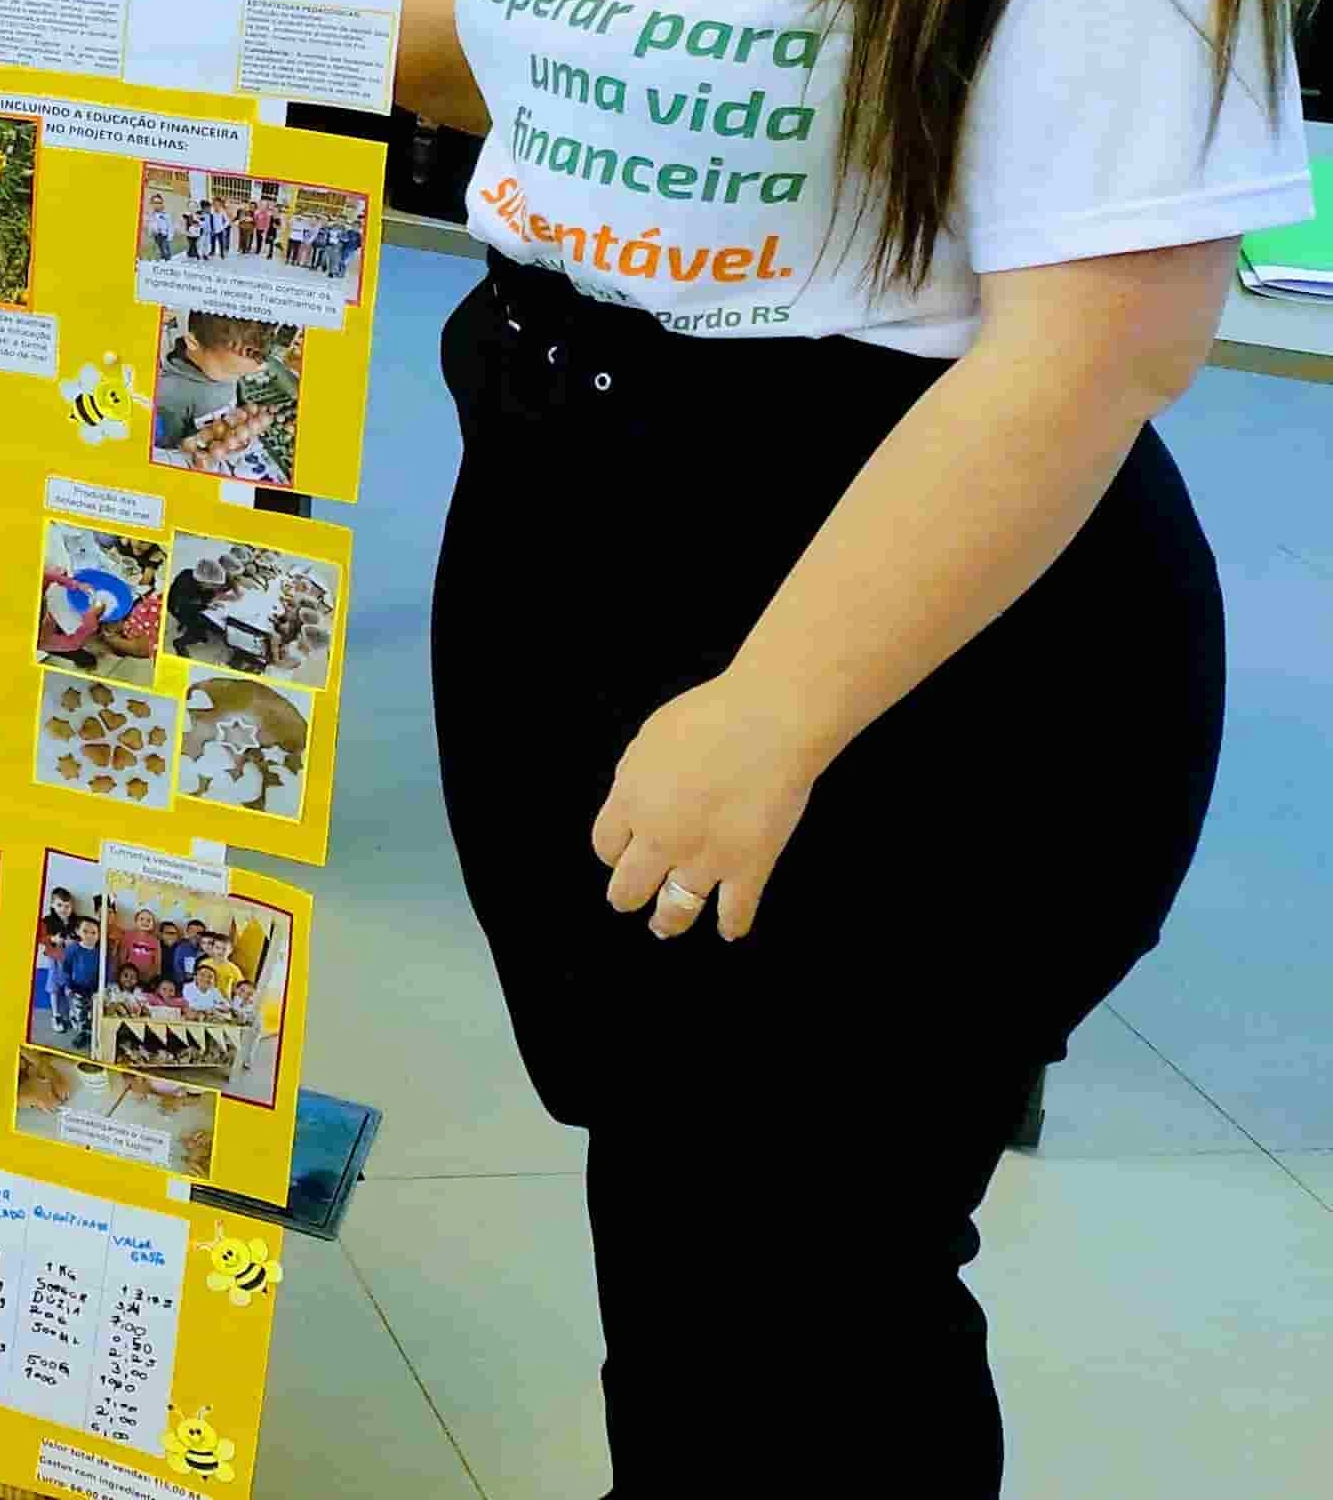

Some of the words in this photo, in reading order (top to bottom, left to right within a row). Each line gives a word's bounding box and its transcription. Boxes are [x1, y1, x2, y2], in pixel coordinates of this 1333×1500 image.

[634, 7, 825, 69] para
[531, 53, 626, 115] uma
[646, 83, 816, 142] vida
[1, 99, 70, 117] INCLUINDO
[74, 111, 83, 119] A
[86, 111, 156, 130] EDUCAÇÃO
[160, 121, 239, 141] FINANCEIRA
[45, 123, 65, 134] NO
[69, 124, 123, 142] PROJETO
[126, 134, 189, 151] ABELHAS:
[512, 105, 809, 205] financeira
[750, 304, 791, 325] RS
[39, 1455, 73, 1472] Gastos
[75, 1468, 96, 1482] com
[41, 1437, 69, 1452] Valor
[71, 1448, 95, 1463] total
[97, 1458, 109, 1468] de
